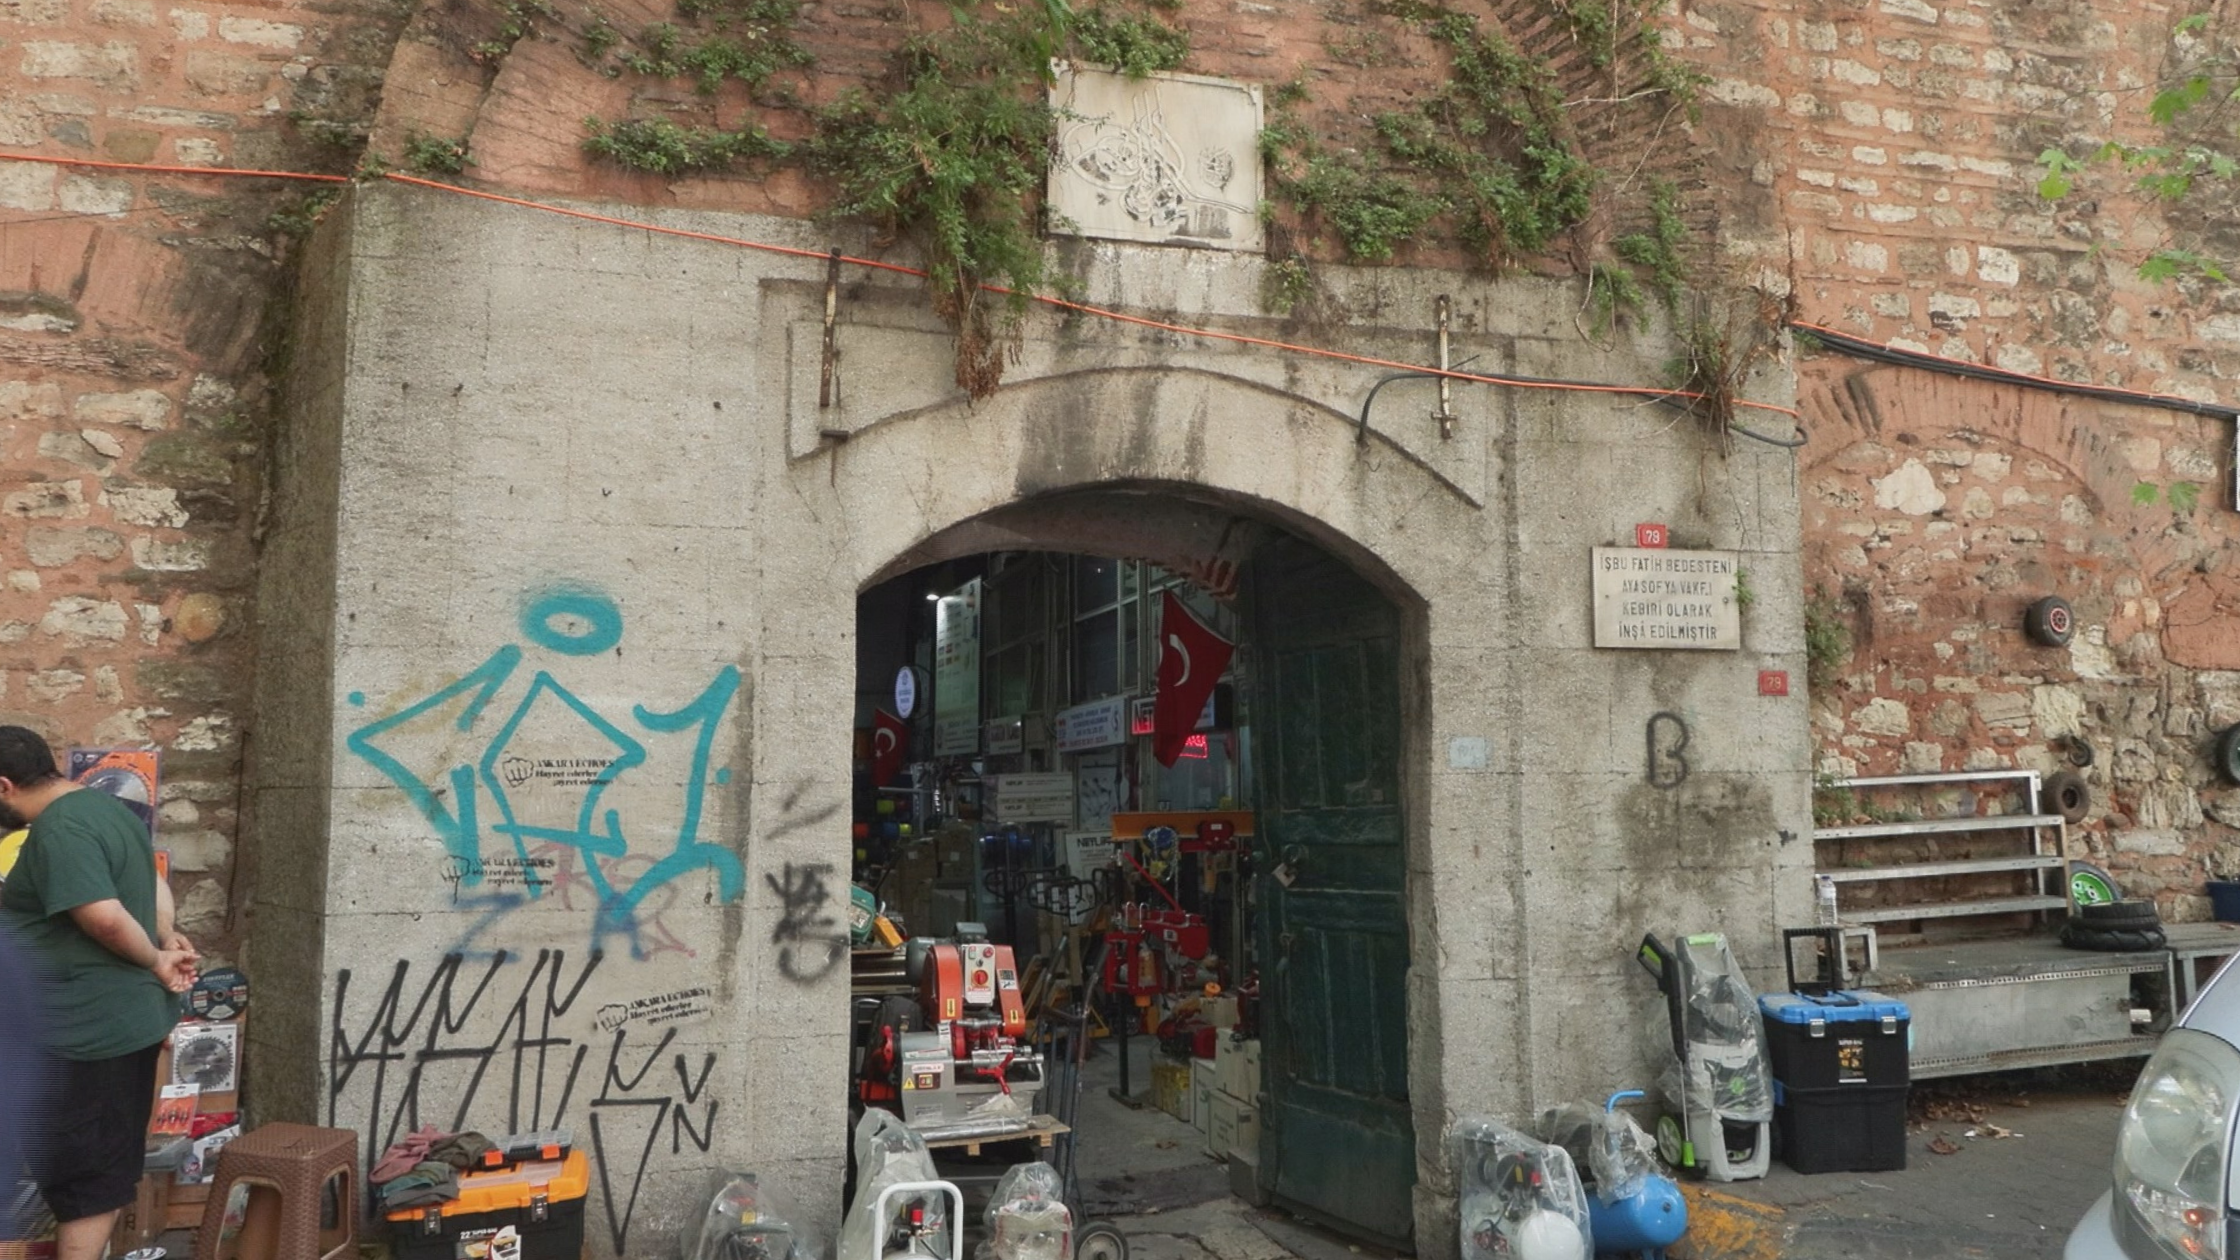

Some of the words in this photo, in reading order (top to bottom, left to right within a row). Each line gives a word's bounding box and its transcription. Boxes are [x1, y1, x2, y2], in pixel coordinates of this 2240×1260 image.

[1632, 555, 1662, 571] FATİH
[1666, 558, 1732, 574] BEDESTENİ
[1622, 579, 1677, 595] AYASOFYA
[1666, 603, 1713, 618] OLARAK
[1650, 621, 1718, 641] EDİLMİŞTİR
